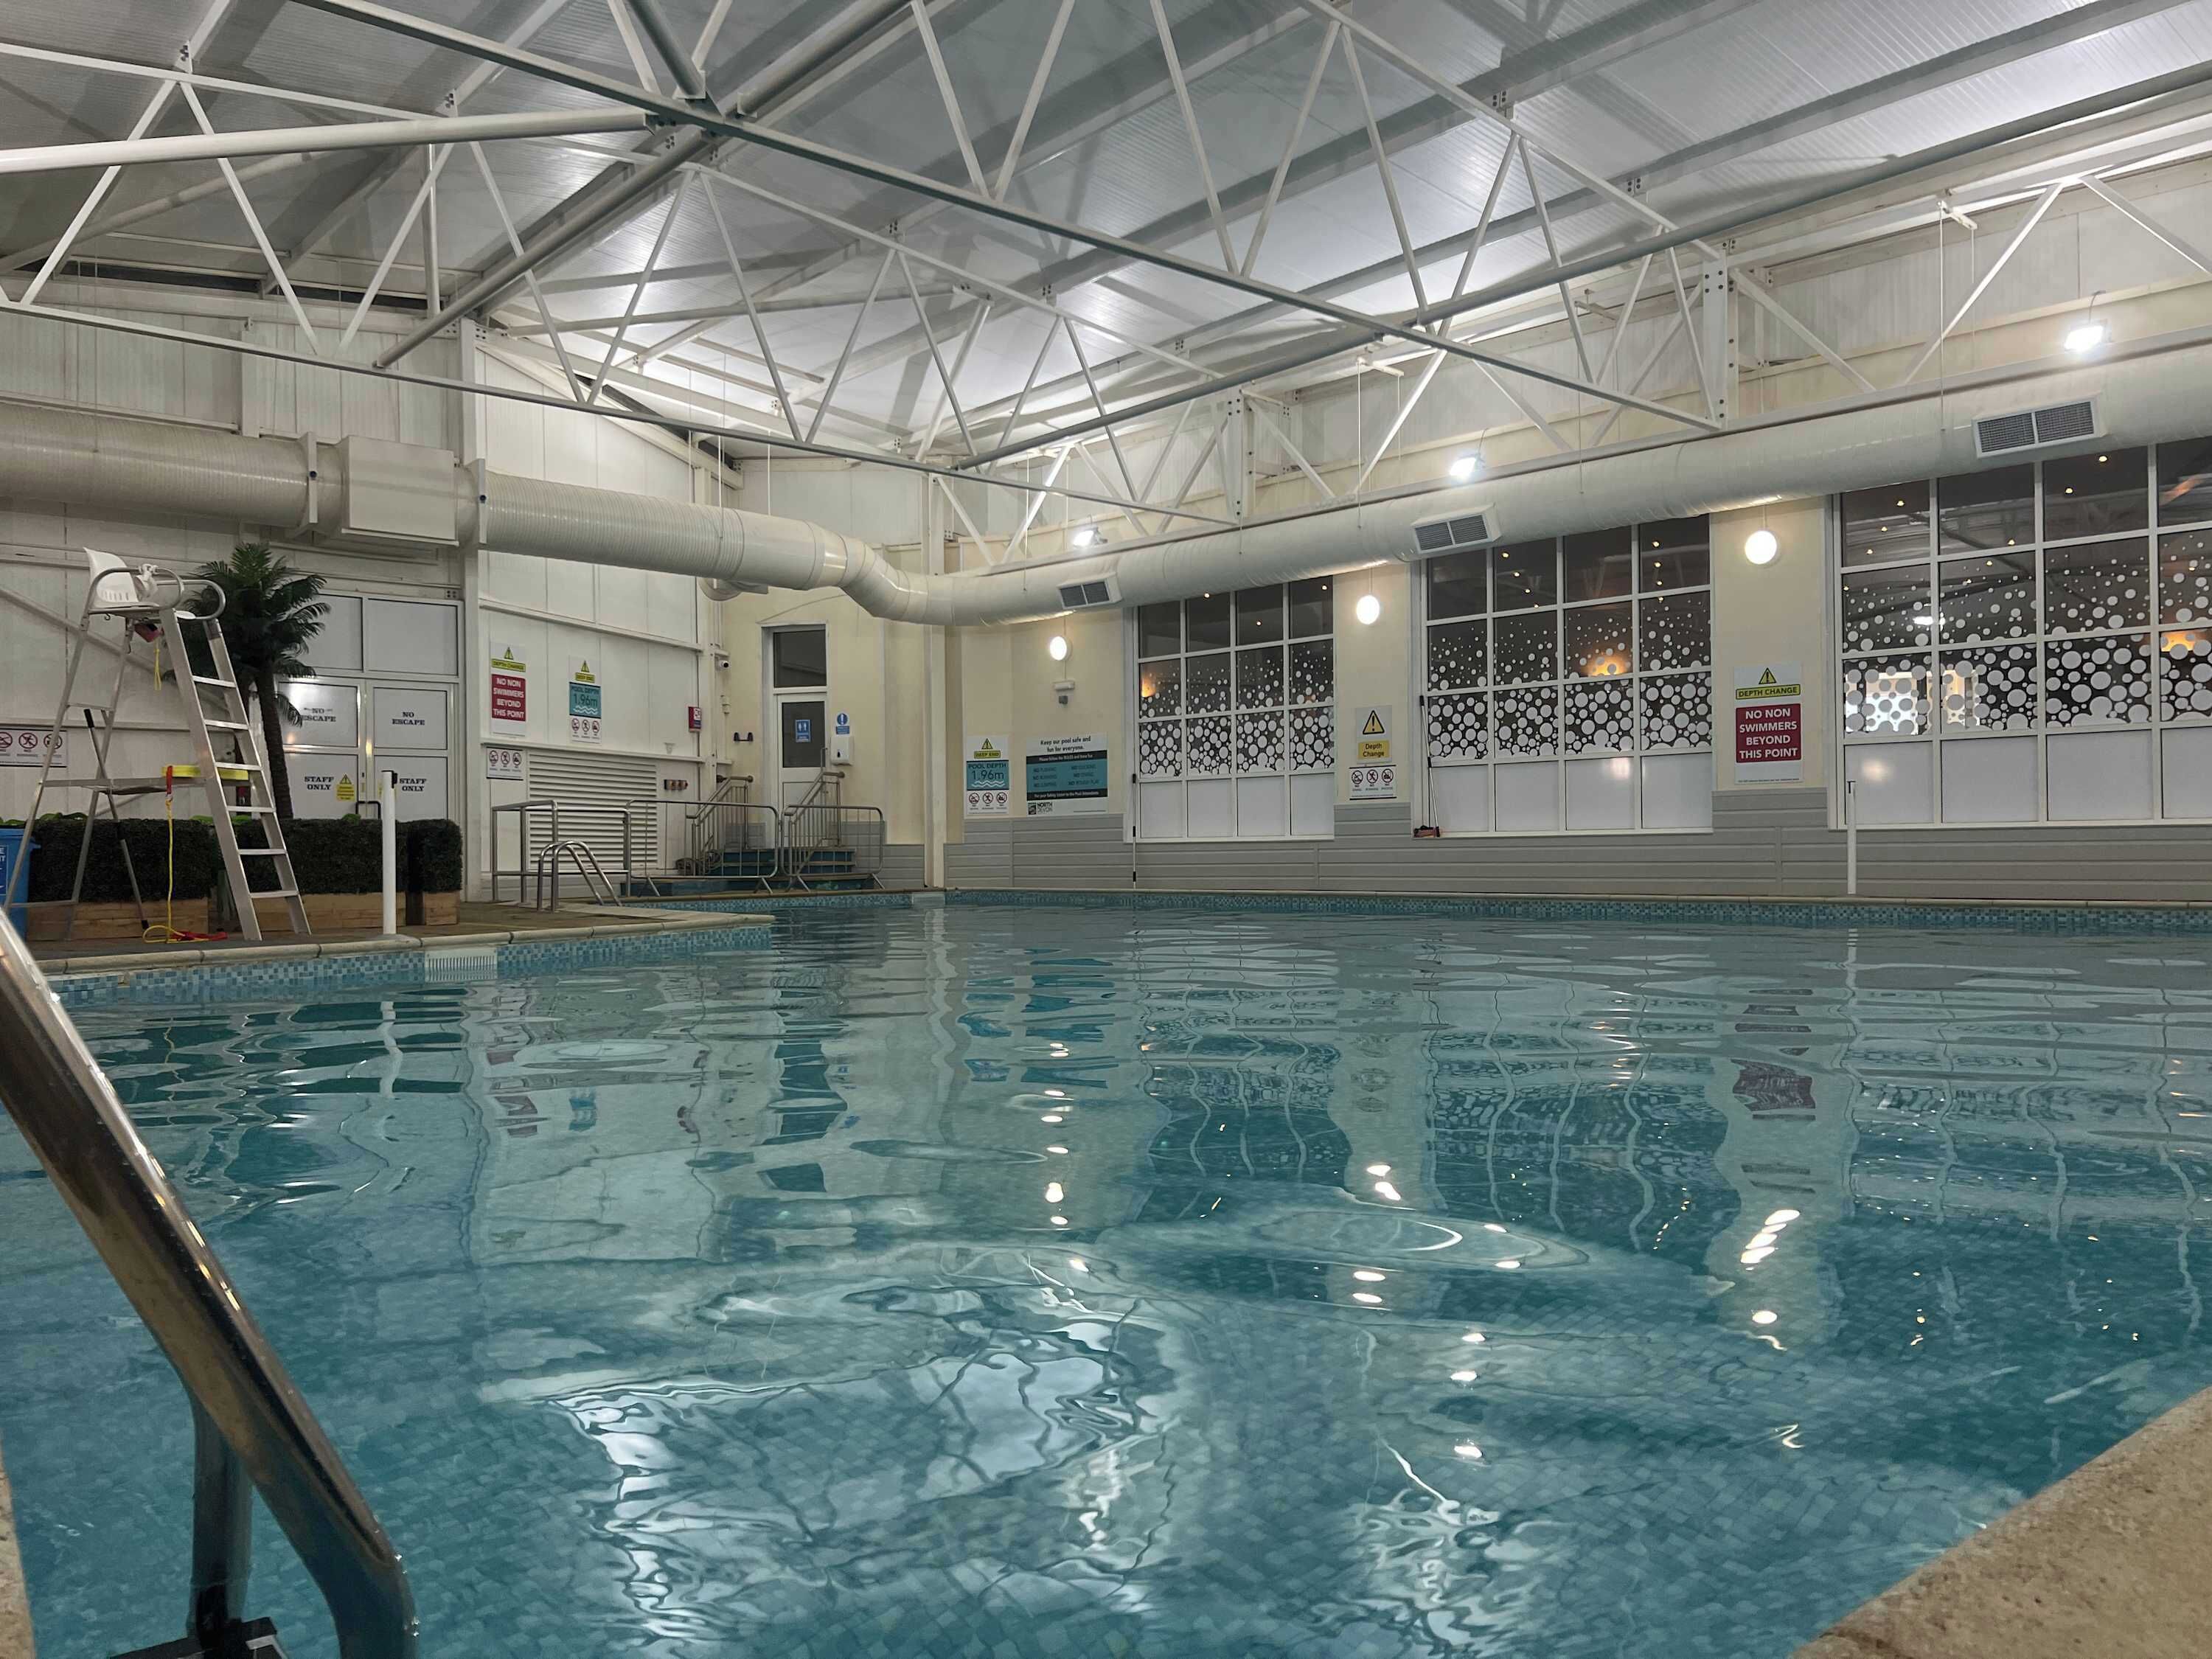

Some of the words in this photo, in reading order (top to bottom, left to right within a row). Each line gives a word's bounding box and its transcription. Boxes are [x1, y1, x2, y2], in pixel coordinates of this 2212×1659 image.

[507, 679, 521, 687] NON
[493, 687, 524, 698] SWIMMERS
[1764, 686, 1798, 695] CHANGE
[497, 698, 521, 708] BEYOND
[574, 694, 598, 707] 1.96m
[493, 708, 506, 716] THIS
[507, 709, 524, 718] POINT
[1745, 710, 1762, 720] NO
[1765, 708, 1791, 718] NON
[1739, 721, 1797, 733] SWIMMERS
[1746, 735, 1791, 745] BEYOND
[1739, 750, 1762, 759] THIS
[1764, 748, 1798, 758] POINT
[972, 770, 1004, 780] 1.96m
